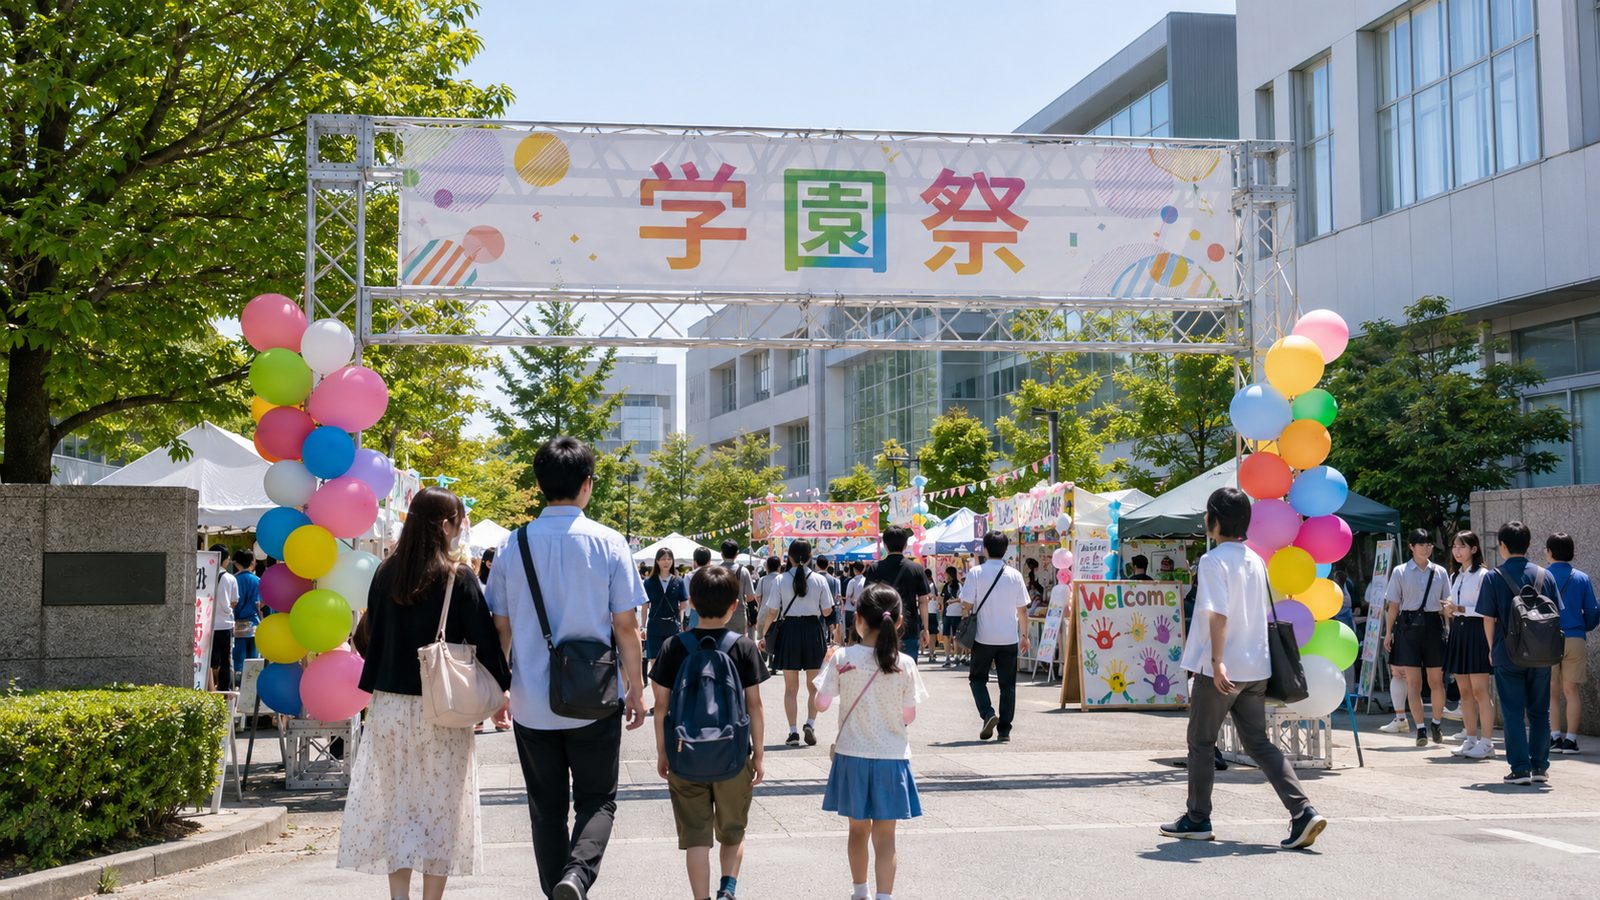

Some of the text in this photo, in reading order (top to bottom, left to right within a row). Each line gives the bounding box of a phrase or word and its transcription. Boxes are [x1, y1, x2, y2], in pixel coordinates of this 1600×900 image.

[639, 162, 1029, 275] 学園祭
[1080, 584, 1177, 611] Welcome
